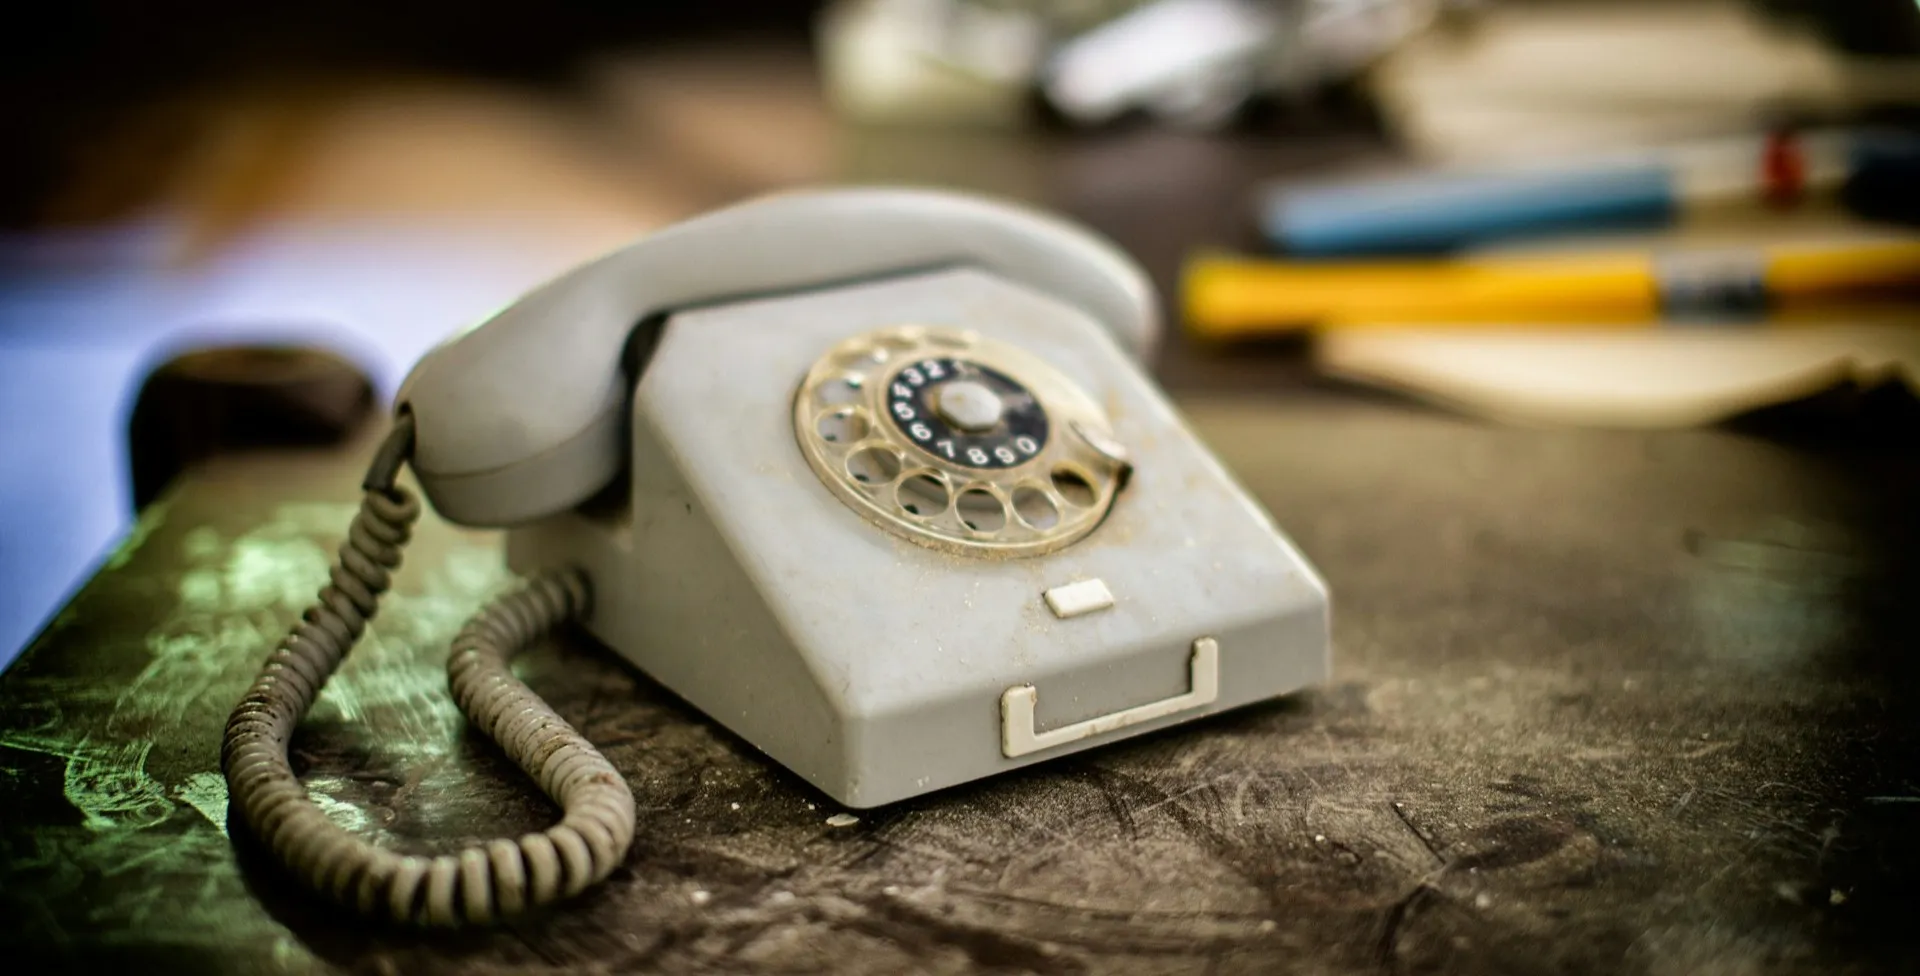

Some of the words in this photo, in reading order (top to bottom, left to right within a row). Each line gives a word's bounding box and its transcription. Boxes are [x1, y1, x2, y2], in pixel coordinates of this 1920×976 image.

[903, 368, 924, 385] 3
[923, 360, 945, 378] 2
[892, 382, 913, 398] 4
[893, 401, 915, 420] 5
[910, 423, 932, 440] 6
[936, 440, 955, 458] 7
[1016, 436, 1037, 454] 0
[967, 448, 988, 465] 8
[994, 446, 1014, 464] 9
